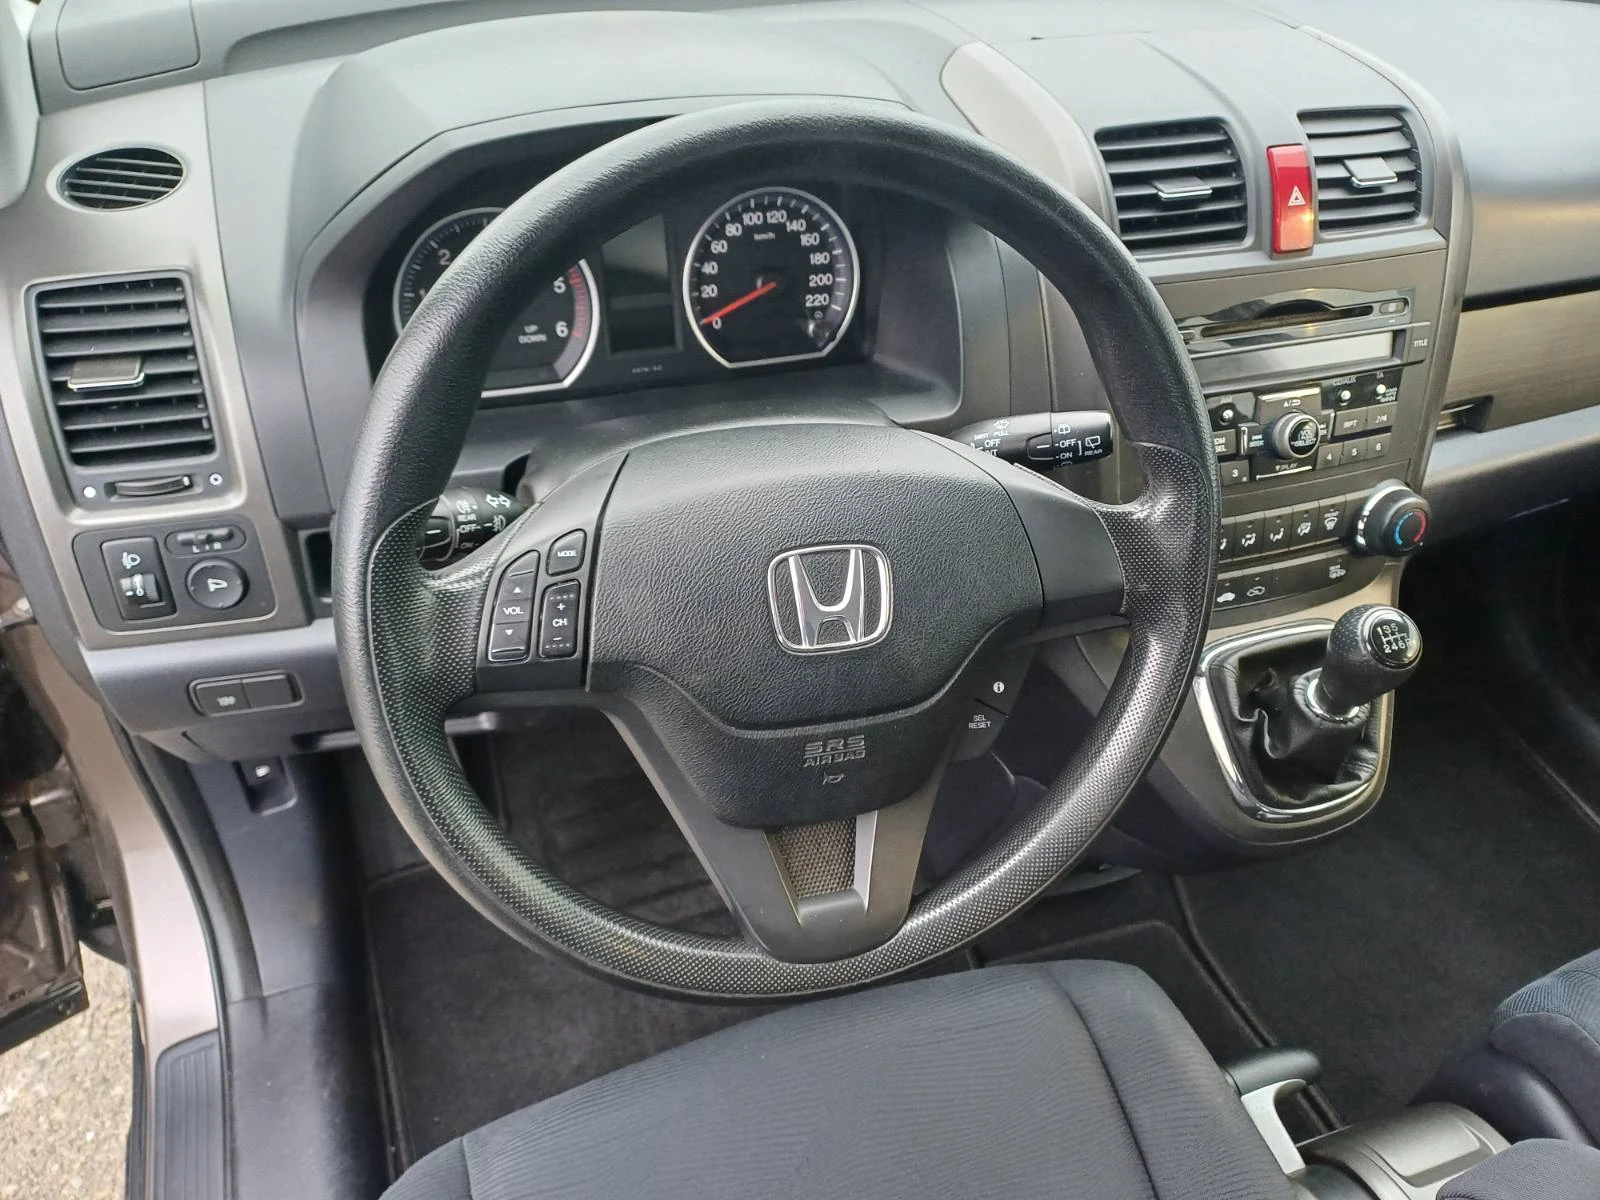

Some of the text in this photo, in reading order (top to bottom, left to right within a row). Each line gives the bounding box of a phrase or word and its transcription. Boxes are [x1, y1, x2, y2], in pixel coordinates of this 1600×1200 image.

[742, 211, 764, 225] 100
[766, 210, 787, 224] 120
[725, 223, 742, 237] 80
[785, 219, 807, 232] 140
[800, 232, 820, 246] 160
[710, 240, 728, 253] 60
[438, 248, 451, 266] 2
[809, 252, 830, 265] 180
[701, 261, 718, 275] 40
[553, 276, 566, 293] 5
[808, 273, 833, 287] 200
[700, 284, 718, 298] 20
[805, 293, 830, 307] 220
[555, 320, 569, 338] 6
[712, 317, 722, 329] 0
[984, 438, 1001, 448] OFF
[1059, 438, 1077, 447] OFF
[1375, 442, 1382, 451] 6
[1084, 449, 1103, 457] REAR
[1326, 453, 1333, 461] 4
[1351, 447, 1358, 456] 5
[1232, 469, 1239, 478] 3
[557, 550, 577, 558] MODE
[503, 607, 524, 615] VOL
[552, 618, 568, 627] CH
[968, 721, 992, 730] RESET
[804, 734, 865, 752] SRS
